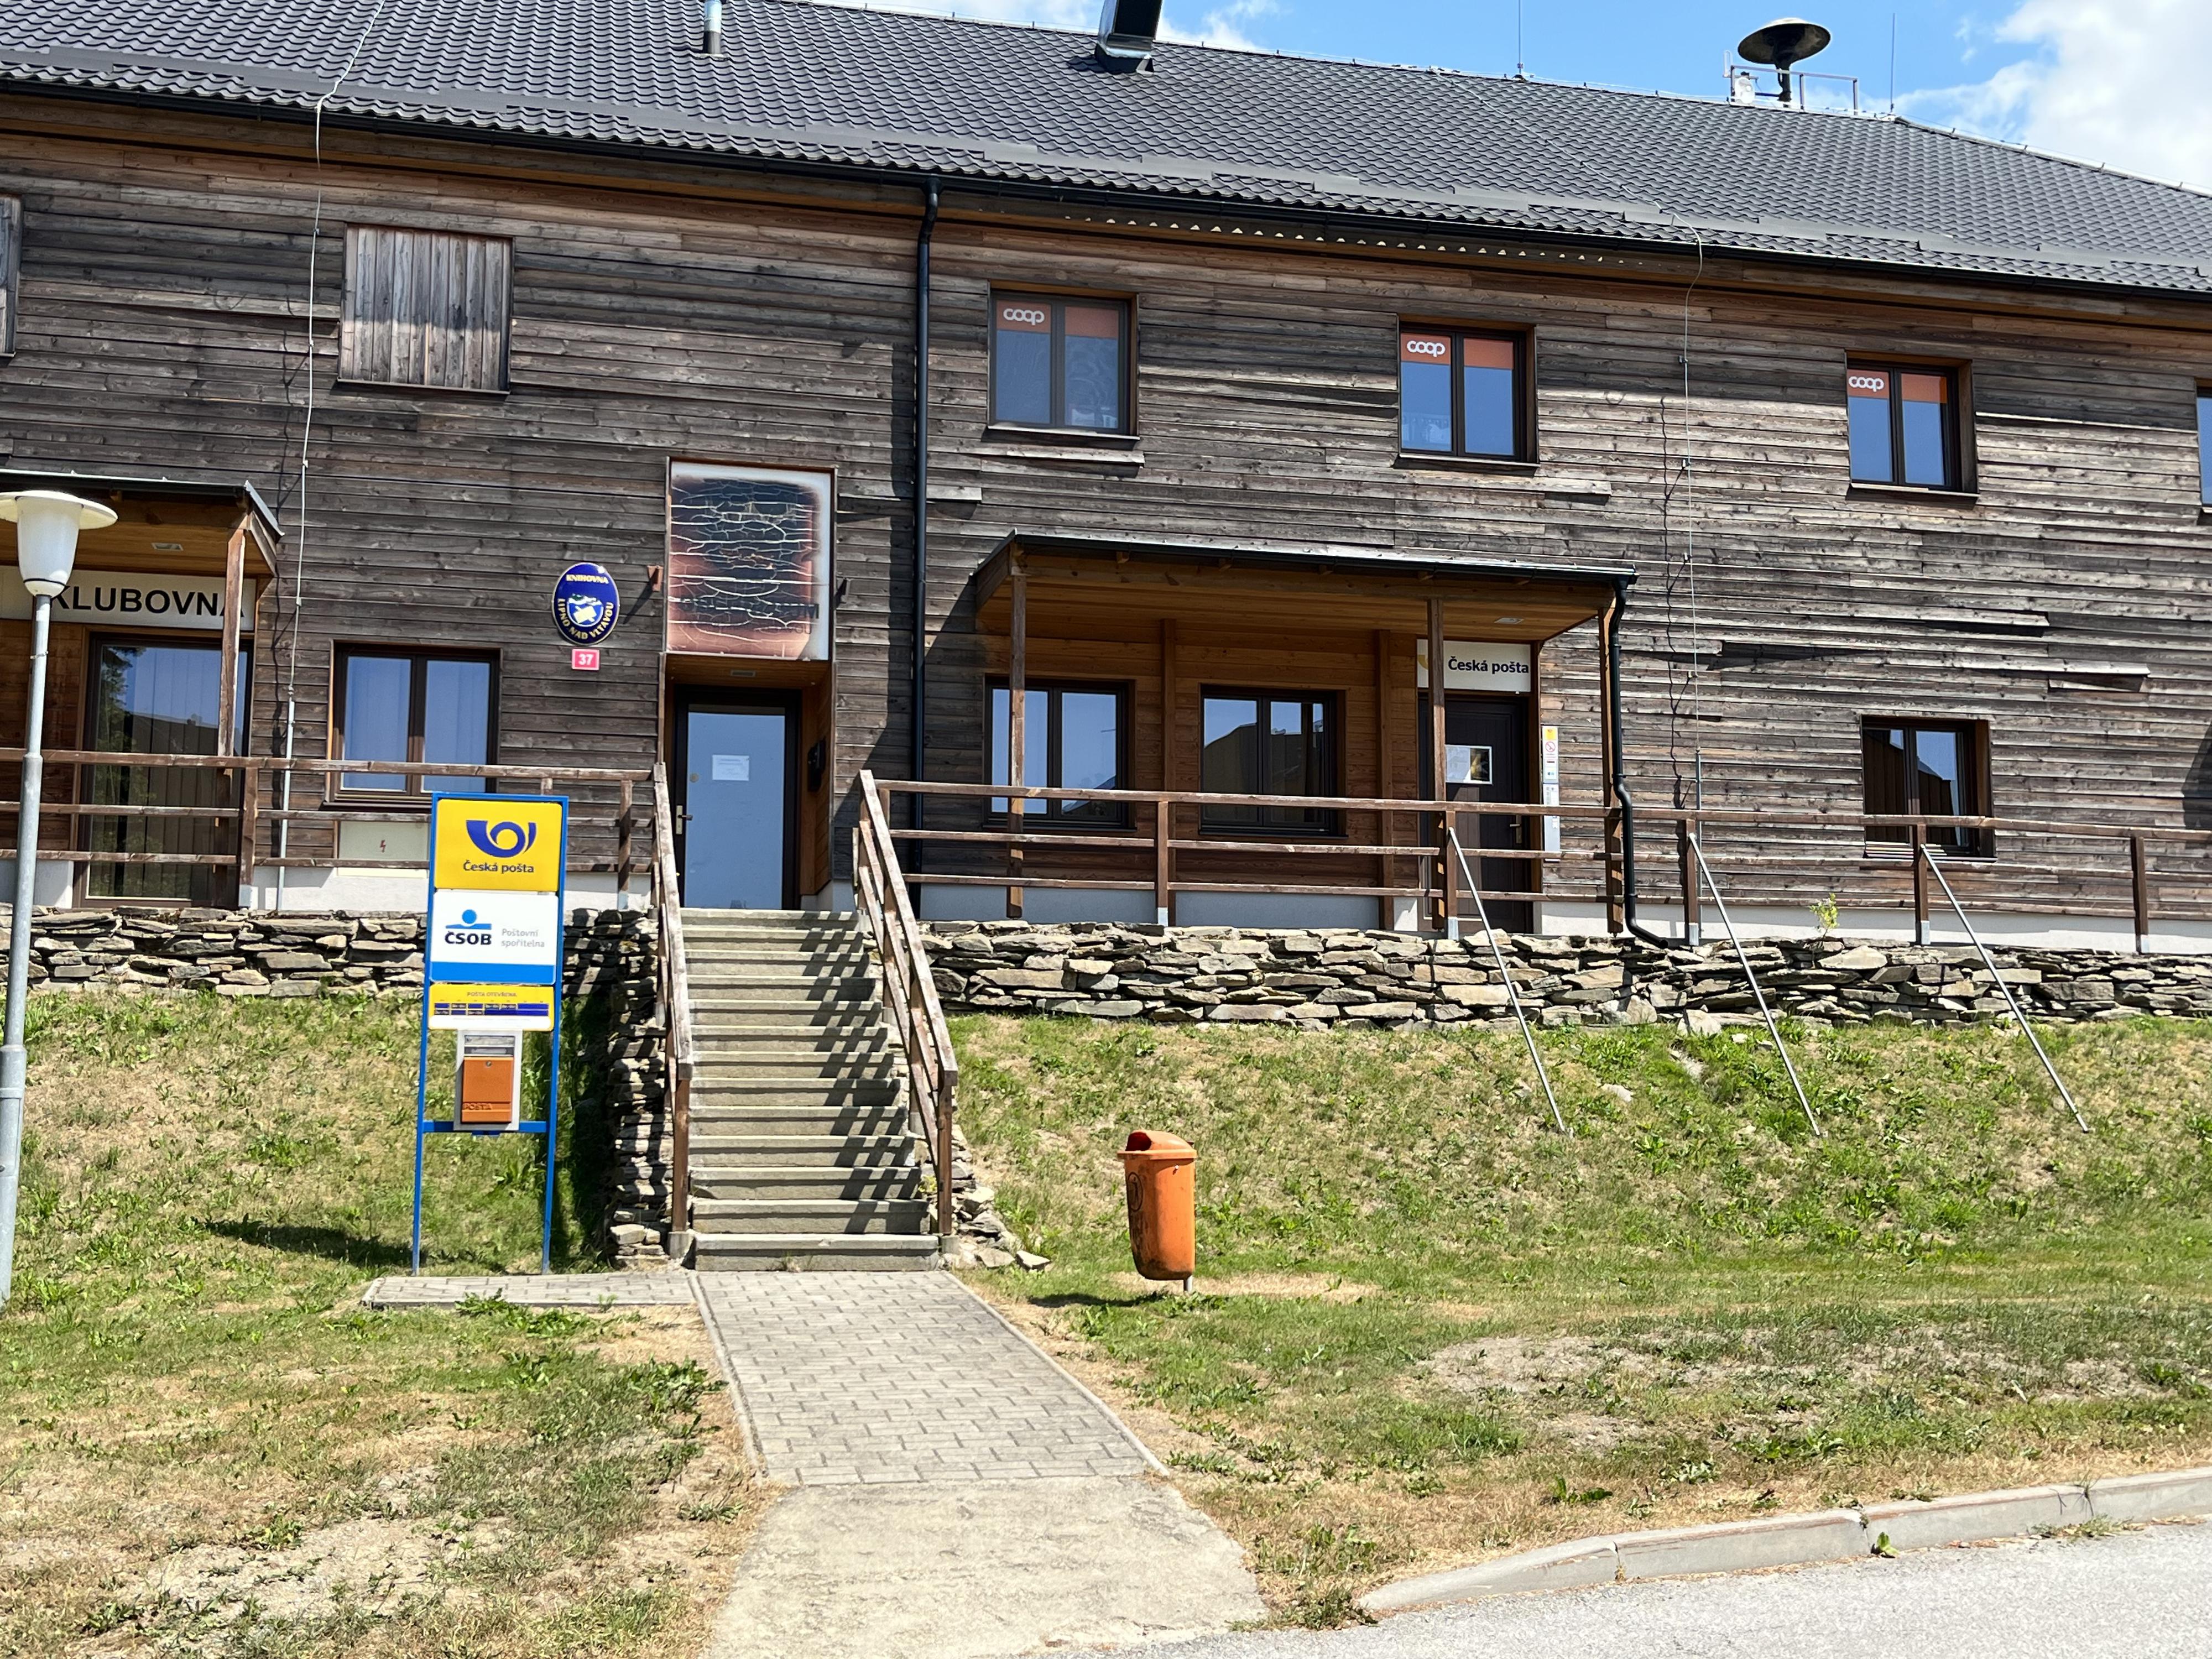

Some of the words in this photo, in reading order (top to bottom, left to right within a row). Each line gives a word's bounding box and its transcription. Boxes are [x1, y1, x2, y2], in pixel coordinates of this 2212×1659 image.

[1003, 308, 1045, 326] coop
[1407, 341, 1446, 357] coop
[1848, 376, 1884, 392] coop
[566, 574, 609, 584] KNIHOVNA
[557, 598, 570, 627] LIPNO
[568, 626, 588, 640] NAD
[589, 602, 614, 638] VLTAVOU
[578, 654, 593, 666] 37
[1448, 656, 1488, 672] Česká
[1491, 661, 1529, 675] pošta
[463, 859, 498, 872] Česká
[501, 863, 534, 874] pošta
[445, 930, 492, 946] ČSOB
[502, 928, 539, 937] Poštovní
[501, 938, 545, 948] spořitelna
